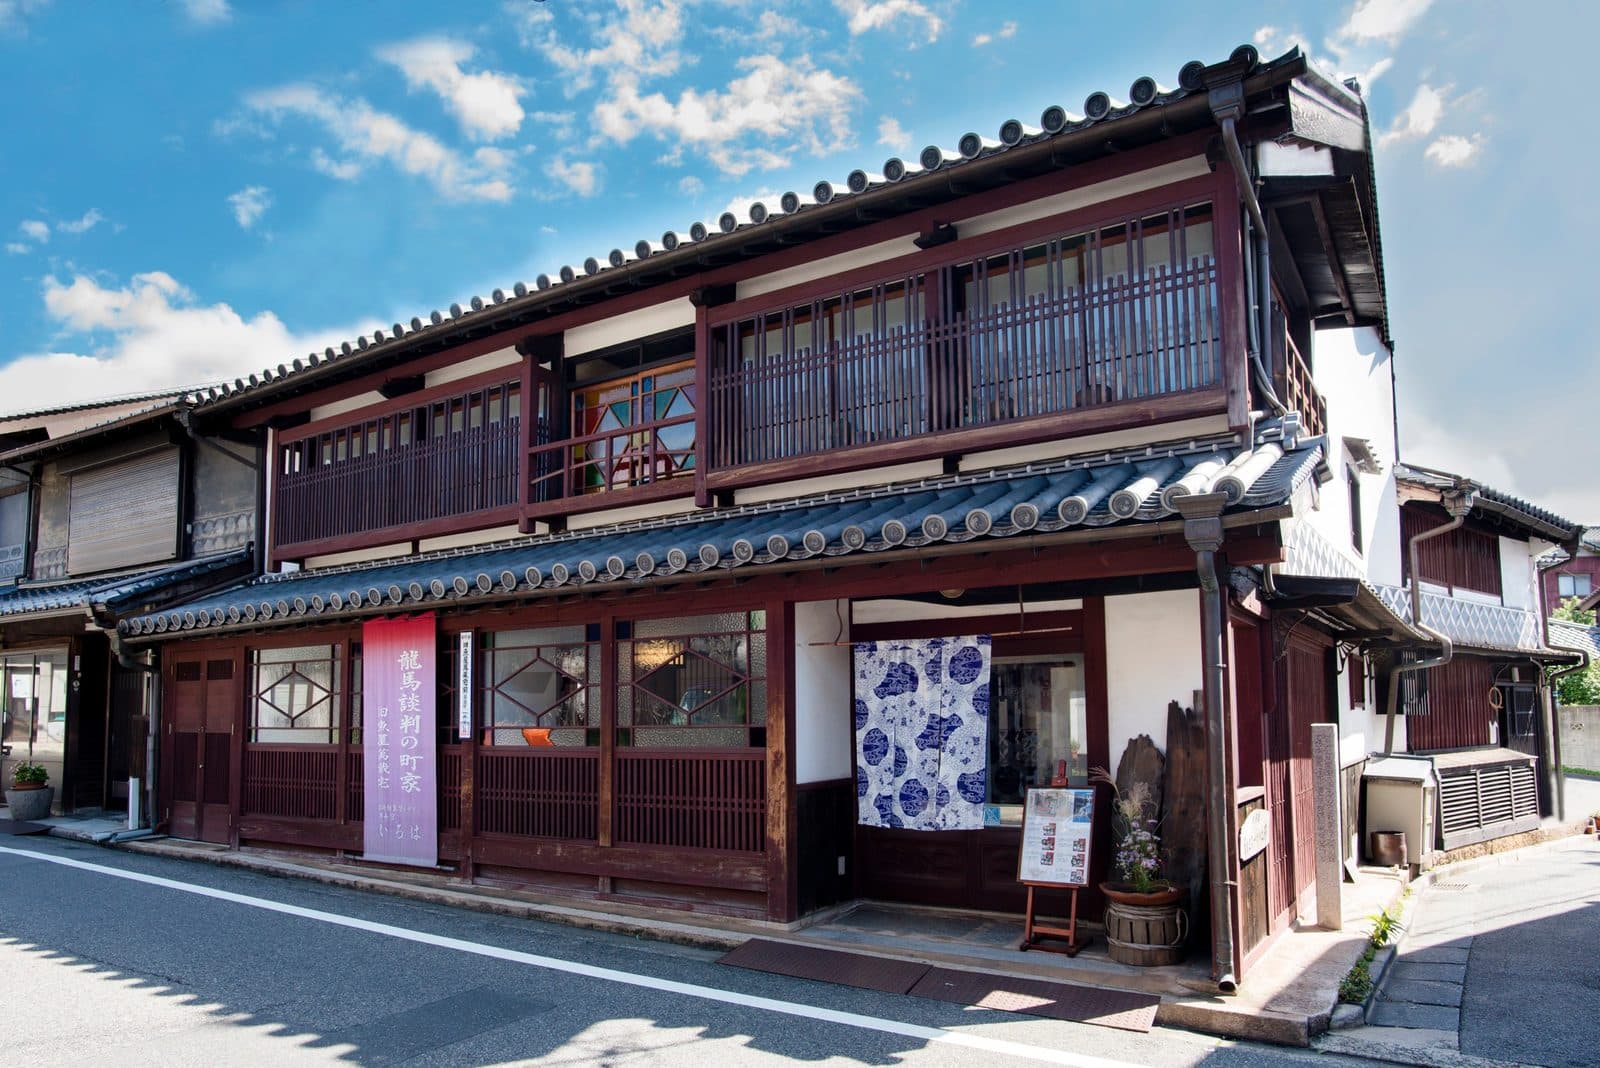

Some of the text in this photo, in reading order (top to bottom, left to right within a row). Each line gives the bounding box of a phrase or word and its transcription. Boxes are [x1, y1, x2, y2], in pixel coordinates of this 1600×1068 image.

[398, 650, 423, 793] 龍馬談判の町家
